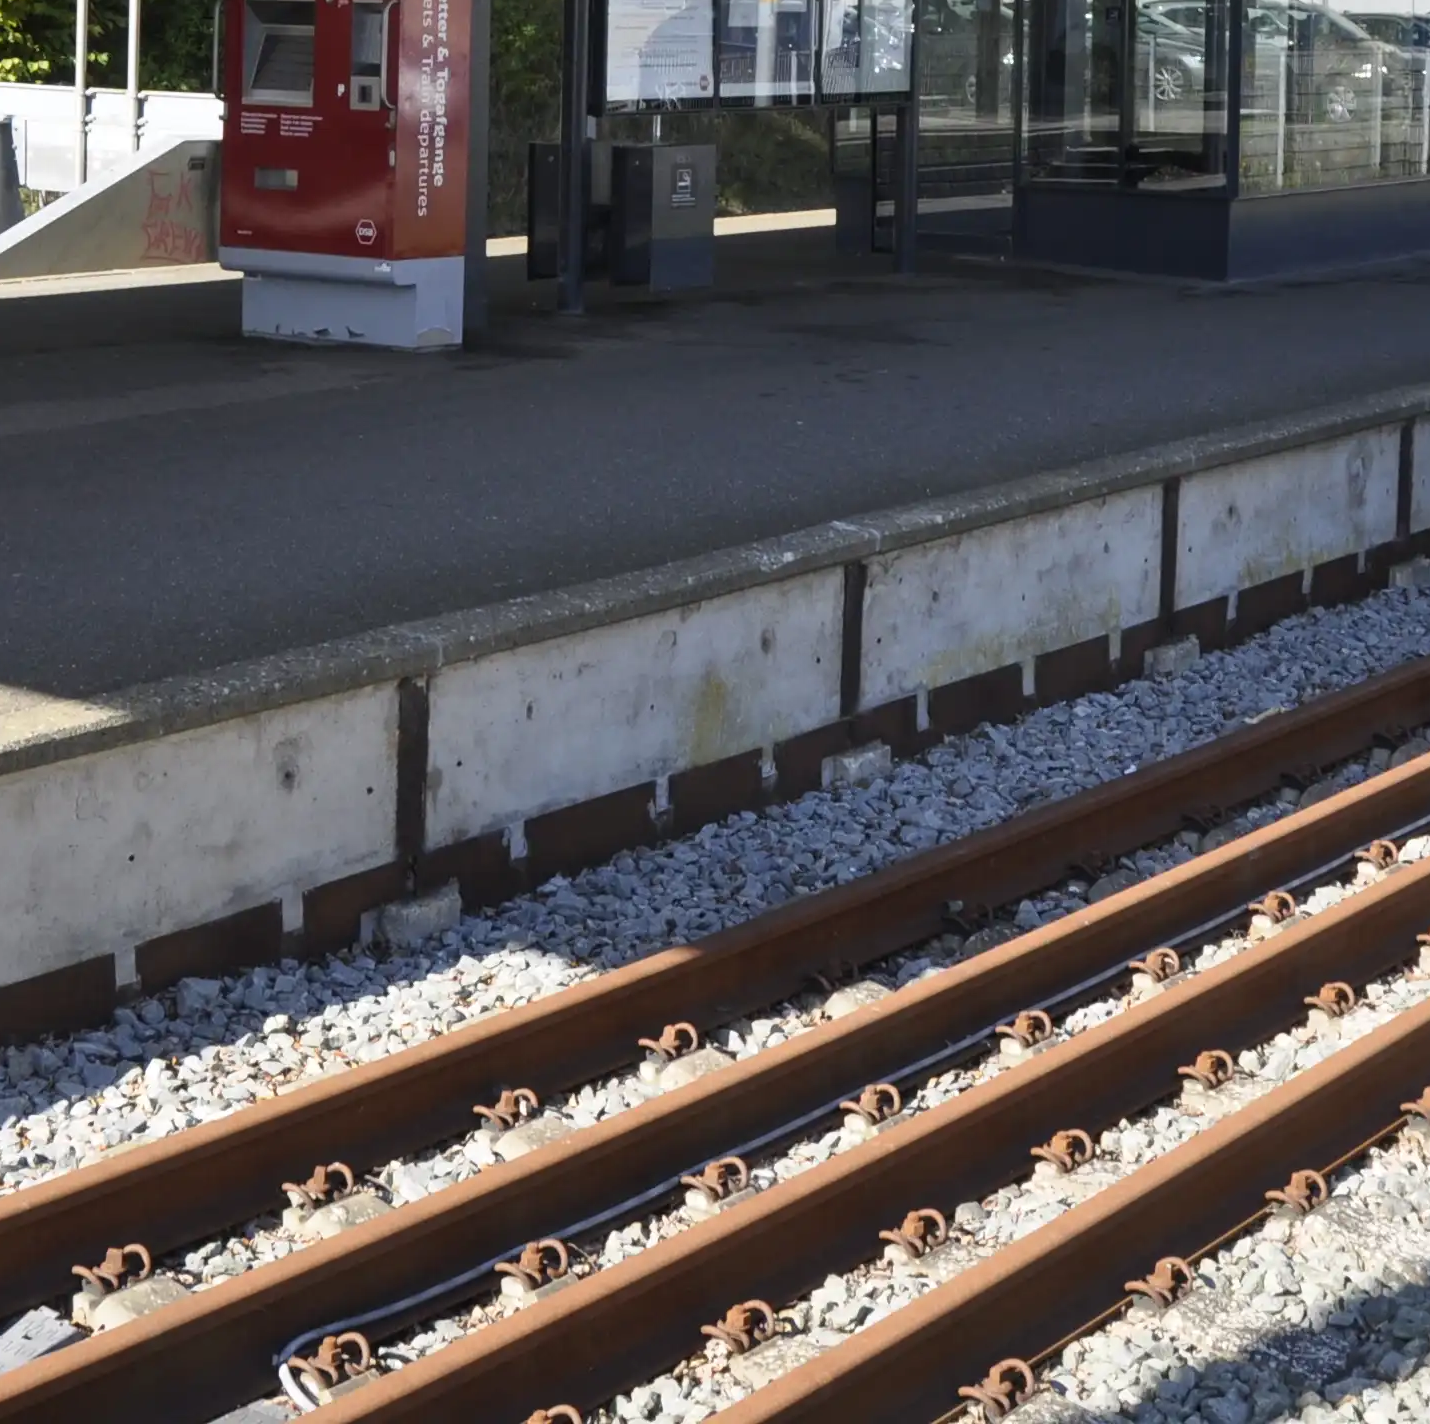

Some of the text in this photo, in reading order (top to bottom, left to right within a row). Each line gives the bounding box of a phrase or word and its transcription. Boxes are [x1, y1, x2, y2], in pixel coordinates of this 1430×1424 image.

[422, 34, 434, 48] &
[437, 46, 449, 62] &
[420, 54, 434, 103] Train
[432, 67, 449, 187] Togafgange
[417, 109, 432, 217] departures
